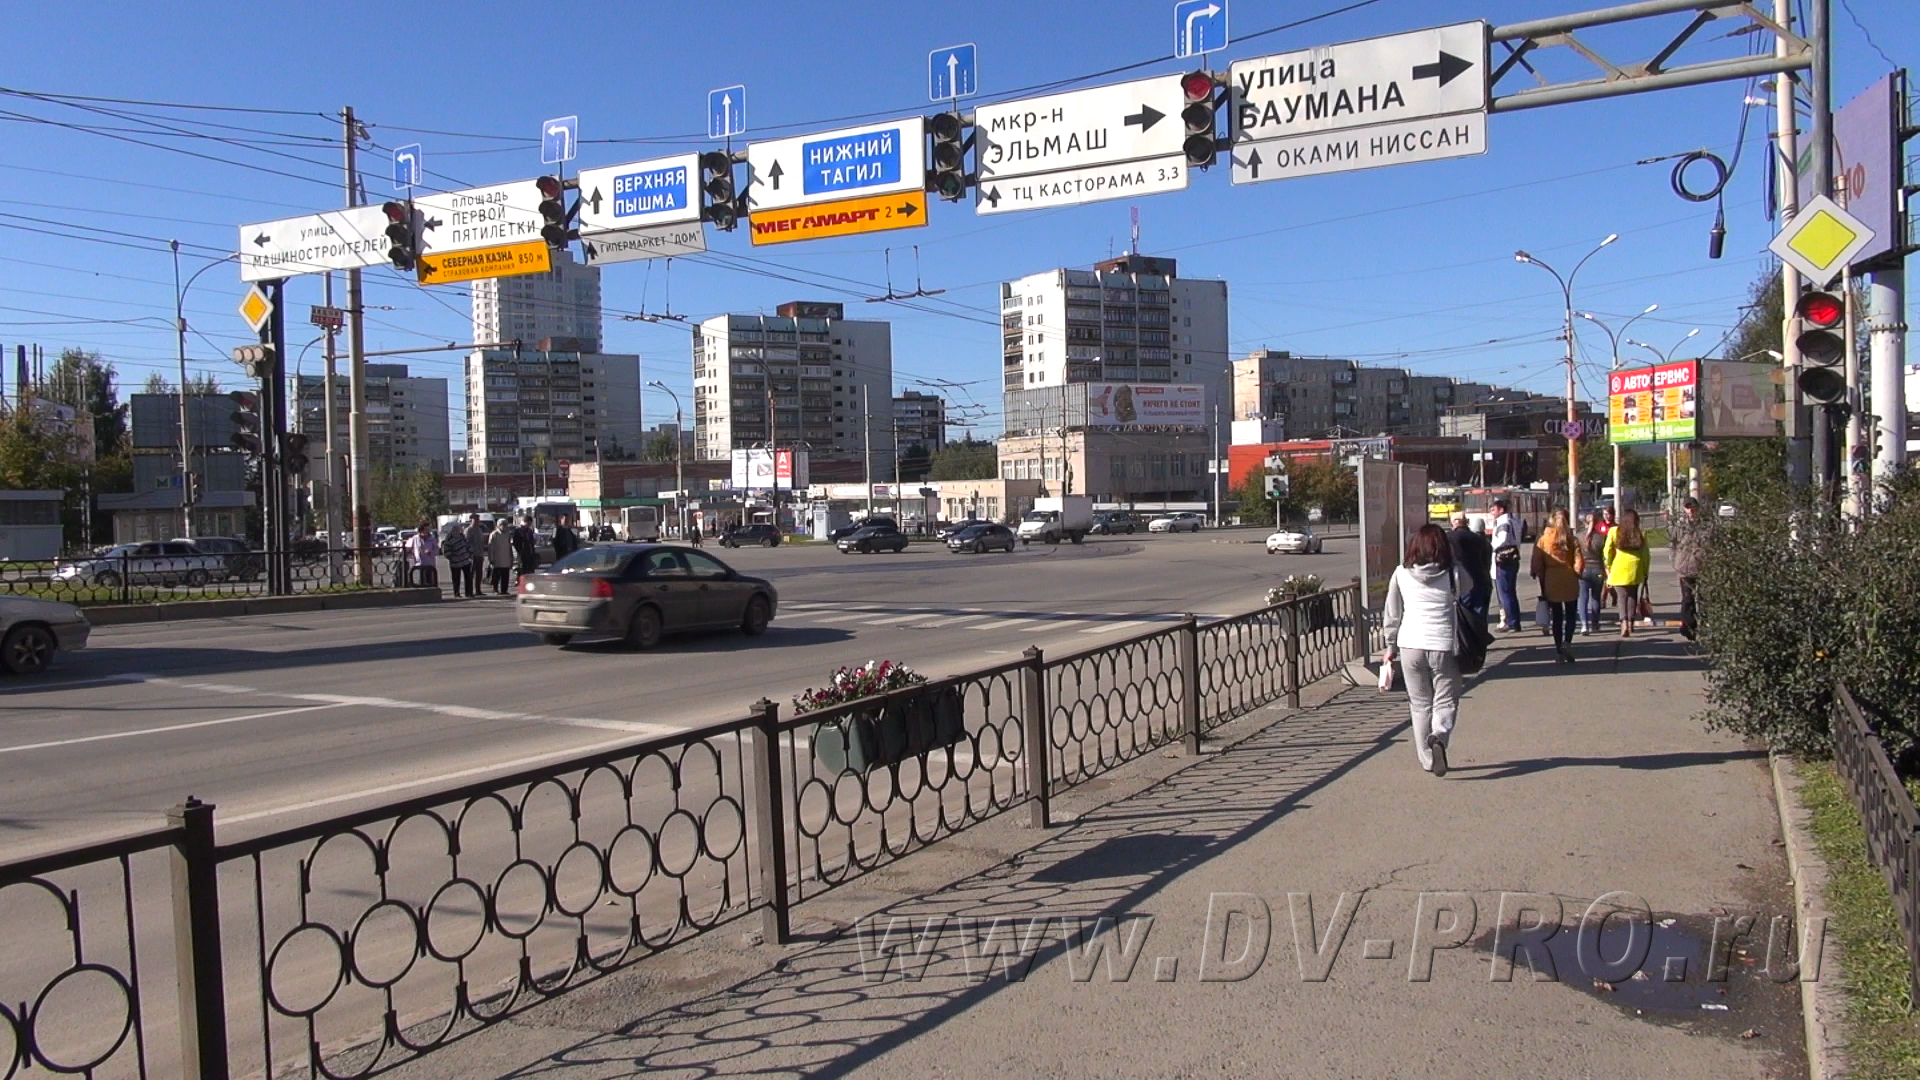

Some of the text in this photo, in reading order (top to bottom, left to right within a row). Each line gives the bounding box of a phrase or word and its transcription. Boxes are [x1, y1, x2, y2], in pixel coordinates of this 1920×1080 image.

[1239, 58, 1336, 98] улица
[1239, 82, 1405, 130] БАУМАНА
[991, 107, 1064, 133] мкр-н
[810, 132, 893, 166] НИЖНИЙ
[990, 128, 1107, 164] ЭЛЬМАШ
[1276, 124, 1469, 168] ОКАМИ НИССАН
[615, 169, 685, 194] ВЕРХНЯЯ
[820, 162, 882, 186] ТАГИЛ
[1012, 185, 1033, 201] ТЦ
[1039, 171, 1145, 198] КАСТОРАМА
[451, 191, 509, 209] площадь
[615, 193, 675, 215] ПЫШМА
[452, 205, 506, 226] ПЕРВОЙ
[756, 206, 893, 234] МЕГАМАРТ 2
[300, 225, 336, 242] улица
[452, 219, 536, 244] ПЯТИЛЕТКИ
[600, 230, 700, 253] ГИПЕРМАРКЕТ "ДОМ"
[252, 234, 388, 267] МАШИНОСТРОИТЕЛЕЙ
[442, 254, 485, 269] СЕВЕРНАЯ
[485, 250, 514, 265] КАЗНА
[518, 252, 534, 265] 850
